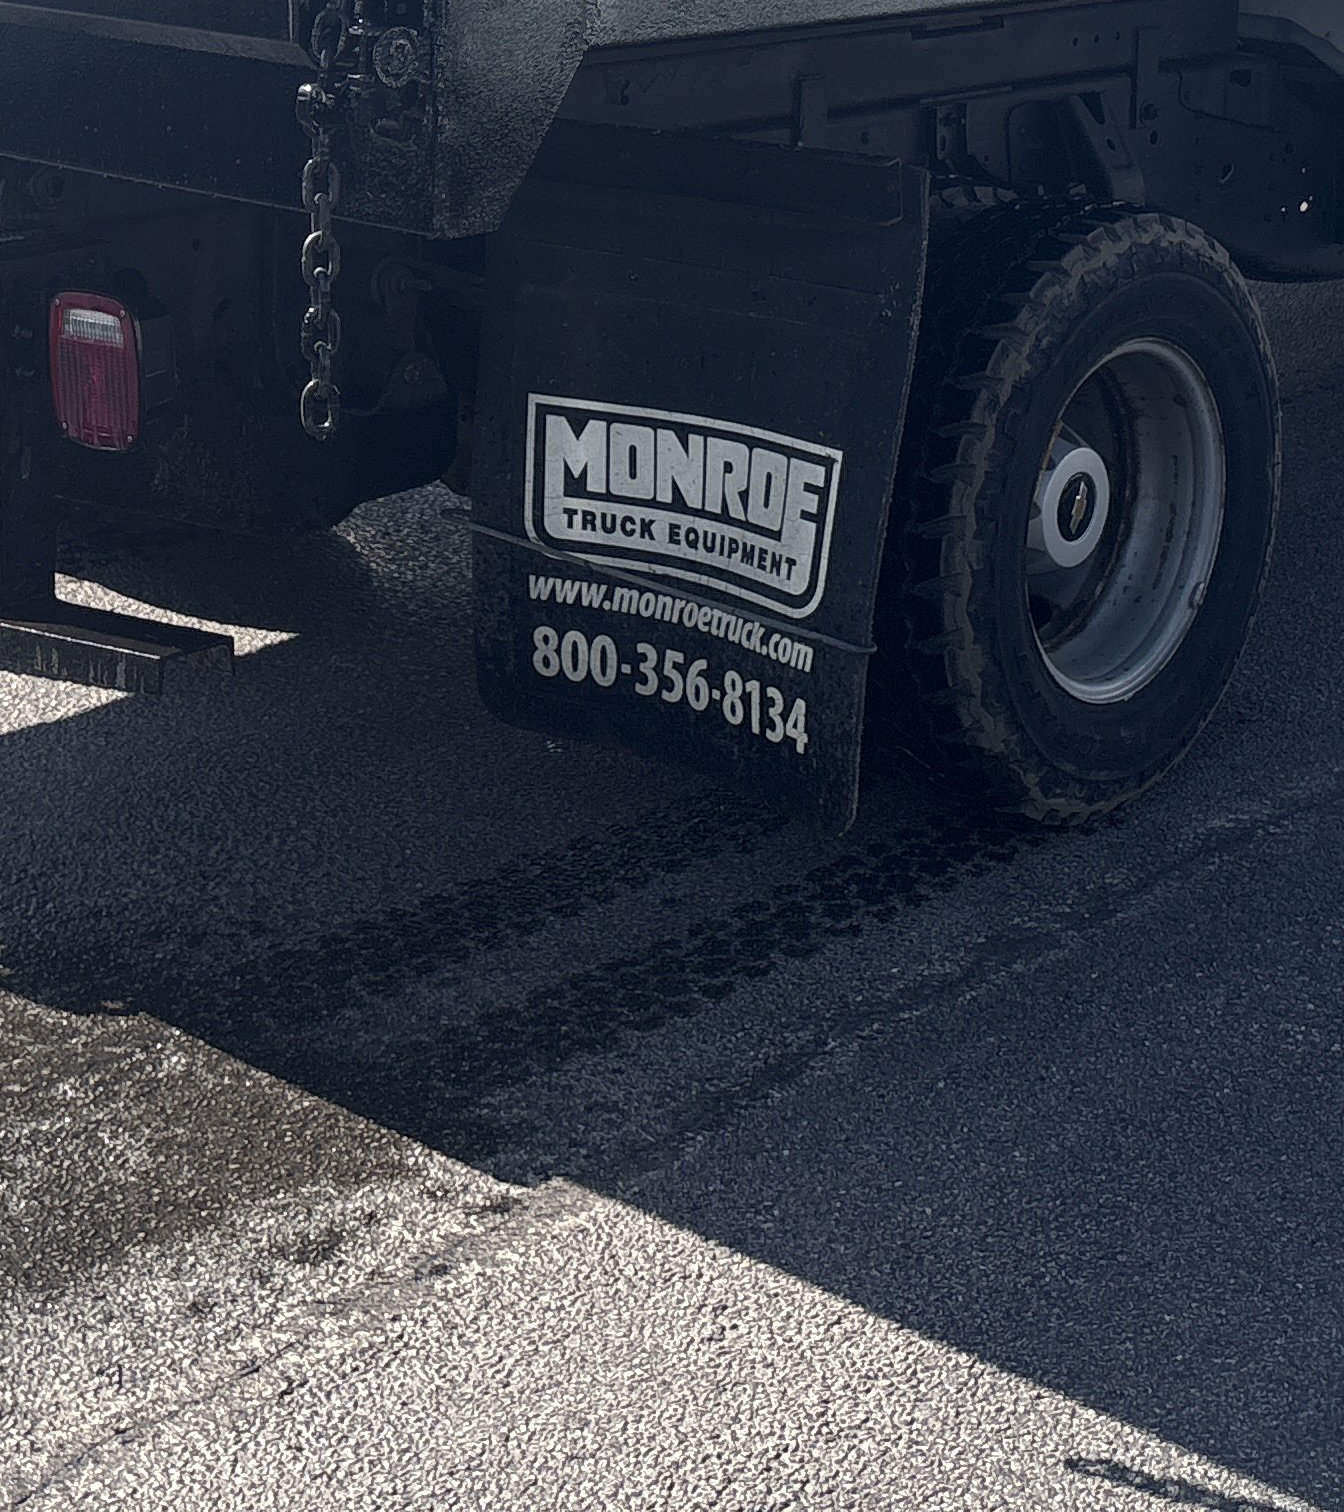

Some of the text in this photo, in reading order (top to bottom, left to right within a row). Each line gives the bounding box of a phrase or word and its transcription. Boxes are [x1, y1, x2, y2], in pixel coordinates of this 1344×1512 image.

[544, 413, 826, 542] MONROE
[562, 506, 797, 582] TRUCK EQUIPMENT
[528, 574, 815, 673] www.monroetruck.com
[532, 625, 809, 755] 800-356-8134
